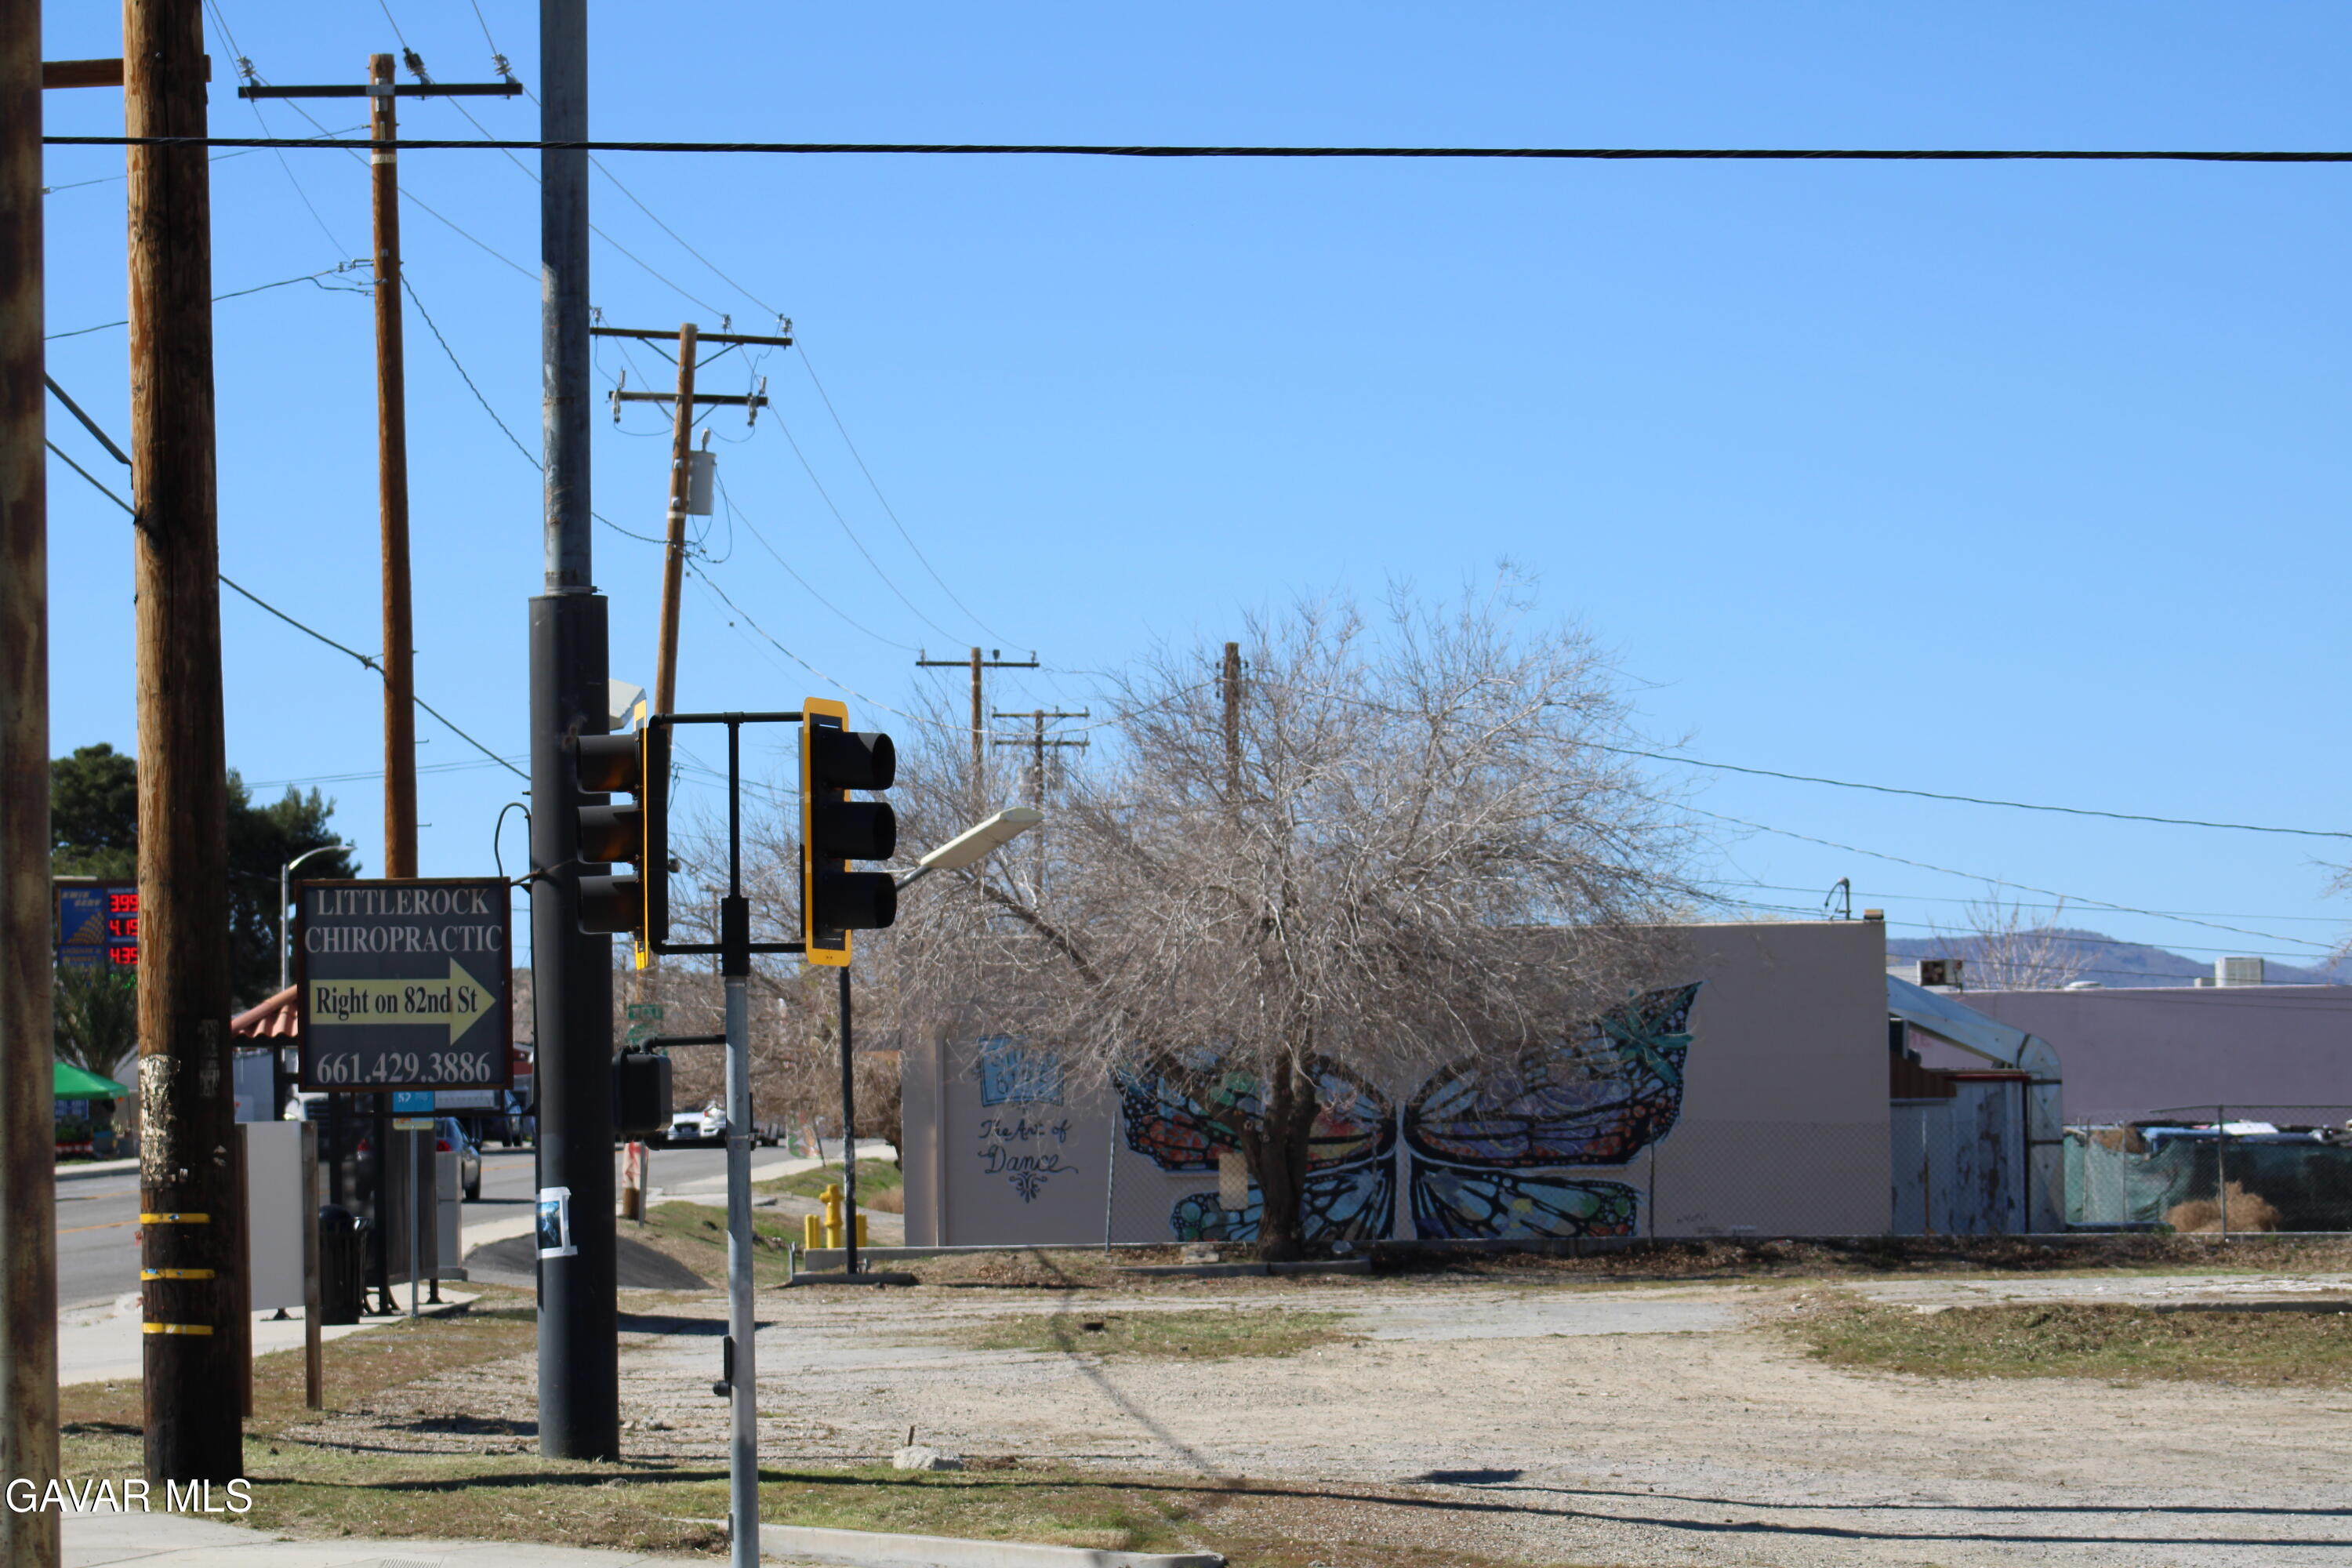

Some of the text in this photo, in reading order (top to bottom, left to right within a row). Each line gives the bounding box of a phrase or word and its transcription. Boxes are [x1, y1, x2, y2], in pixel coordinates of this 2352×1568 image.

[318, 887, 489, 916] LITTLEROCK
[304, 924, 503, 953] CHIROPRACTIC
[316, 985, 477, 1021] Right on 82nd St
[317, 1051, 491, 1083] 661.429.3886
[1051, 1120, 1072, 1143] of
[978, 1144, 1079, 1174] Dance
